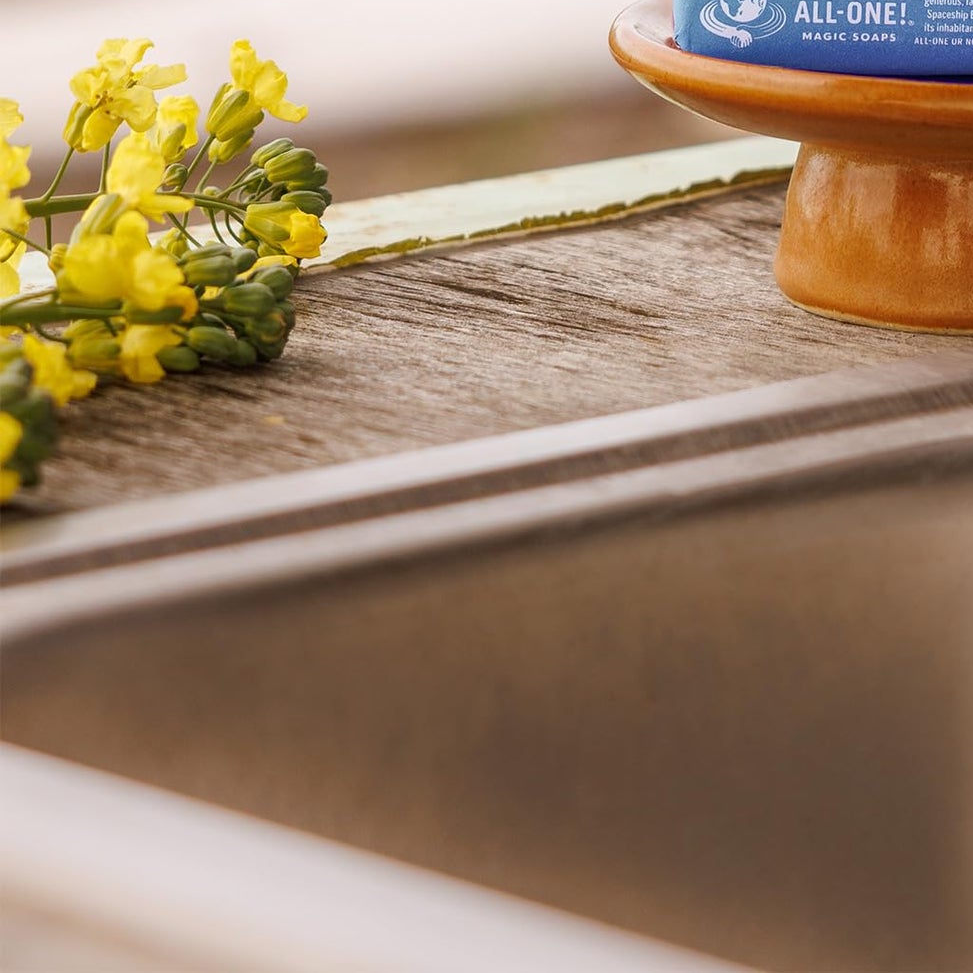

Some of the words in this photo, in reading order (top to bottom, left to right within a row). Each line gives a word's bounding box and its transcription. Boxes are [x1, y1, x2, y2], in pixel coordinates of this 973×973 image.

[927, 9, 969, 21] Spaceship
[924, 23, 935, 32] its
[802, 32, 847, 41] MAGIC
[852, 33, 896, 42] SOAPS
[914, 37, 949, 45] ALL-ONE
[951, 38, 963, 46] OR
